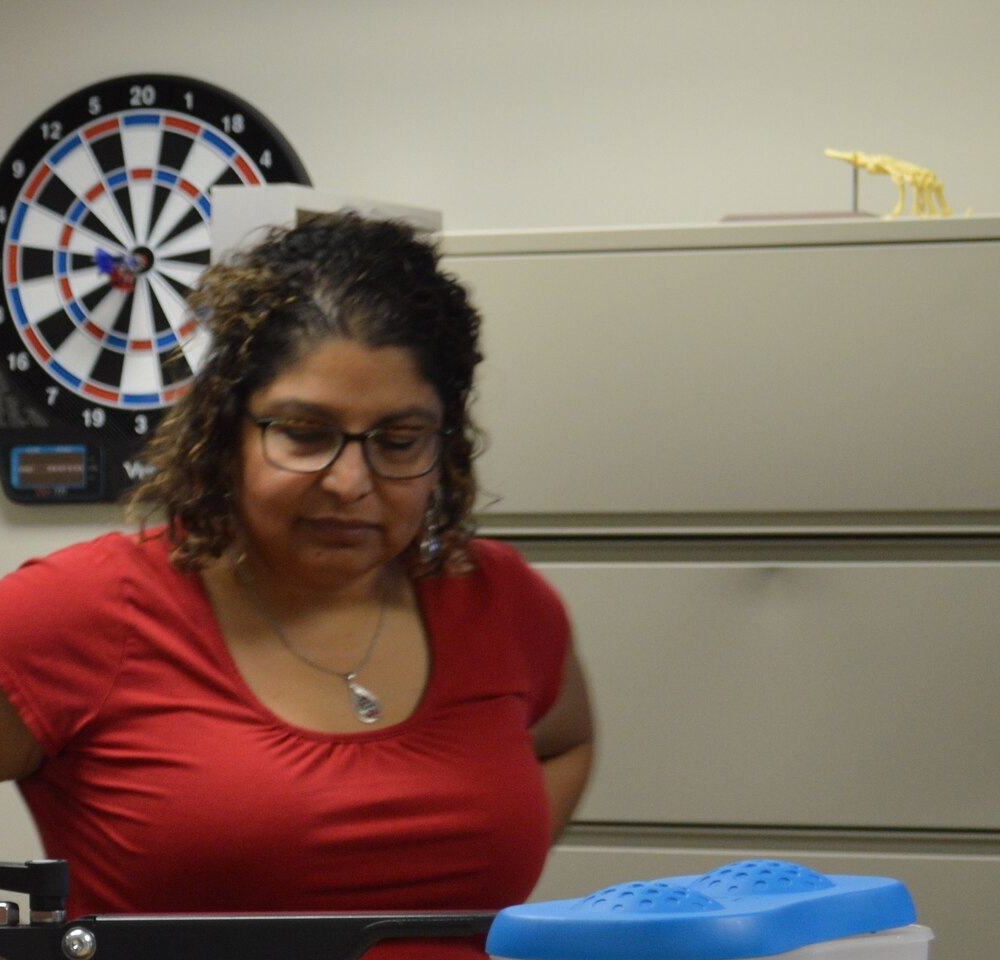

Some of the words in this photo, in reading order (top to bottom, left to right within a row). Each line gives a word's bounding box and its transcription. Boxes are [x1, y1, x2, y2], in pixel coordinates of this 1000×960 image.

[130, 87, 155, 105] 20
[185, 92, 193, 110] 1
[89, 98, 100, 115] 5
[42, 123, 62, 140] 12
[222, 116, 245, 133] 18
[260, 150, 272, 167] 4
[12, 160, 25, 178] 9
[7, 352, 30, 371] 16
[46, 386, 59, 406] 7
[83, 409, 106, 427] 19
[135, 411, 148, 432] 3
